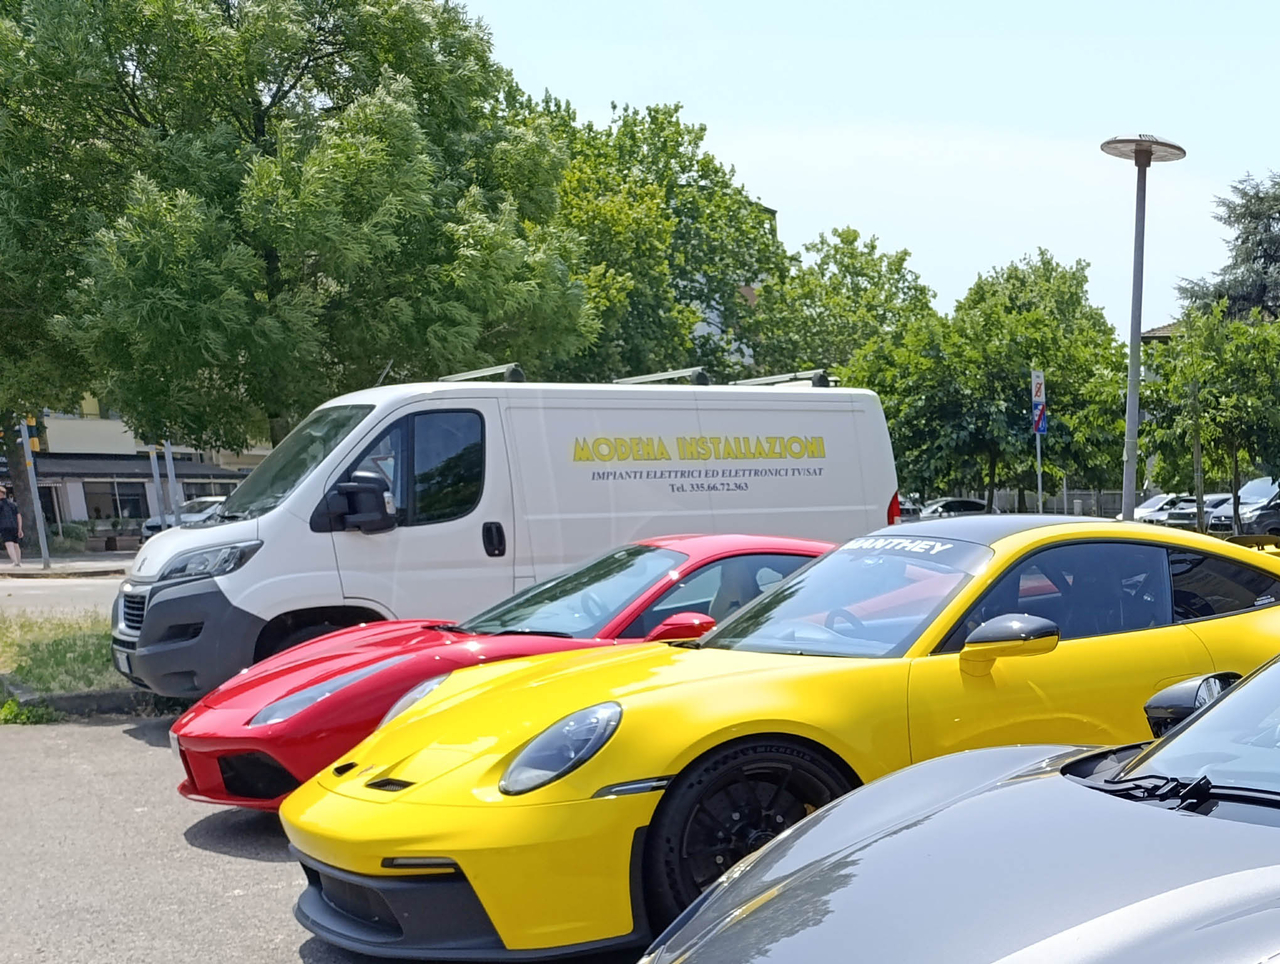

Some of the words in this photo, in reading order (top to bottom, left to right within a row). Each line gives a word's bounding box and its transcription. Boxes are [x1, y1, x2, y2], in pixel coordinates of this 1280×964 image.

[573, 436, 672, 462] MODENA
[678, 435, 826, 461] INSTALLAZIONI
[591, 470, 644, 481] IMPIANTI
[646, 469, 703, 480] ELETTRICI
[704, 468, 719, 479] ED
[721, 467, 788, 478] ELETTRONICI
[669, 482, 687, 493] Tel.
[689, 482, 749, 493] 335.66.72.363
